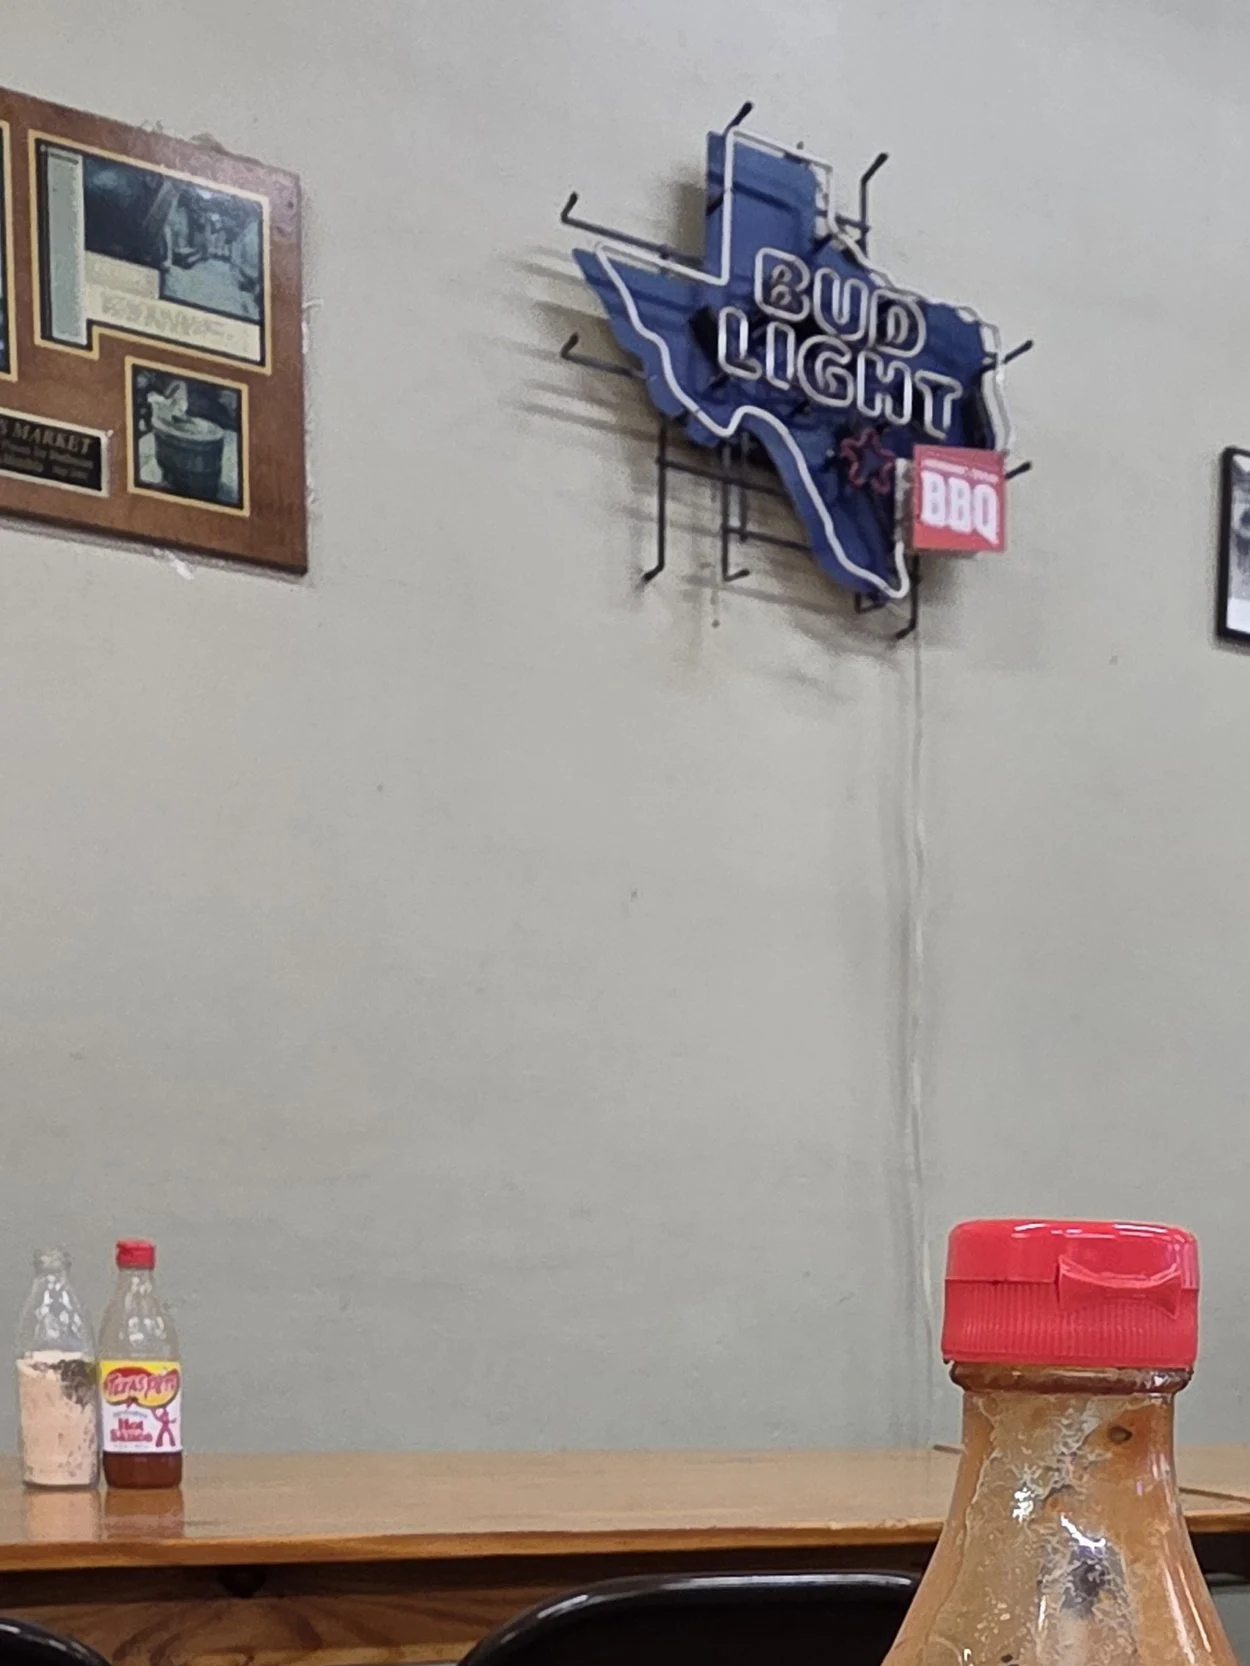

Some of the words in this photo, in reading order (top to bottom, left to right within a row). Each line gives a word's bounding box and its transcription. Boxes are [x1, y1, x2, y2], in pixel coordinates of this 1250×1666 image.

[755, 247, 926, 358] BUD
[718, 307, 964, 440] LIGHT
[12, 421, 92, 456] MARKET
[920, 470, 1000, 546] BBQ
